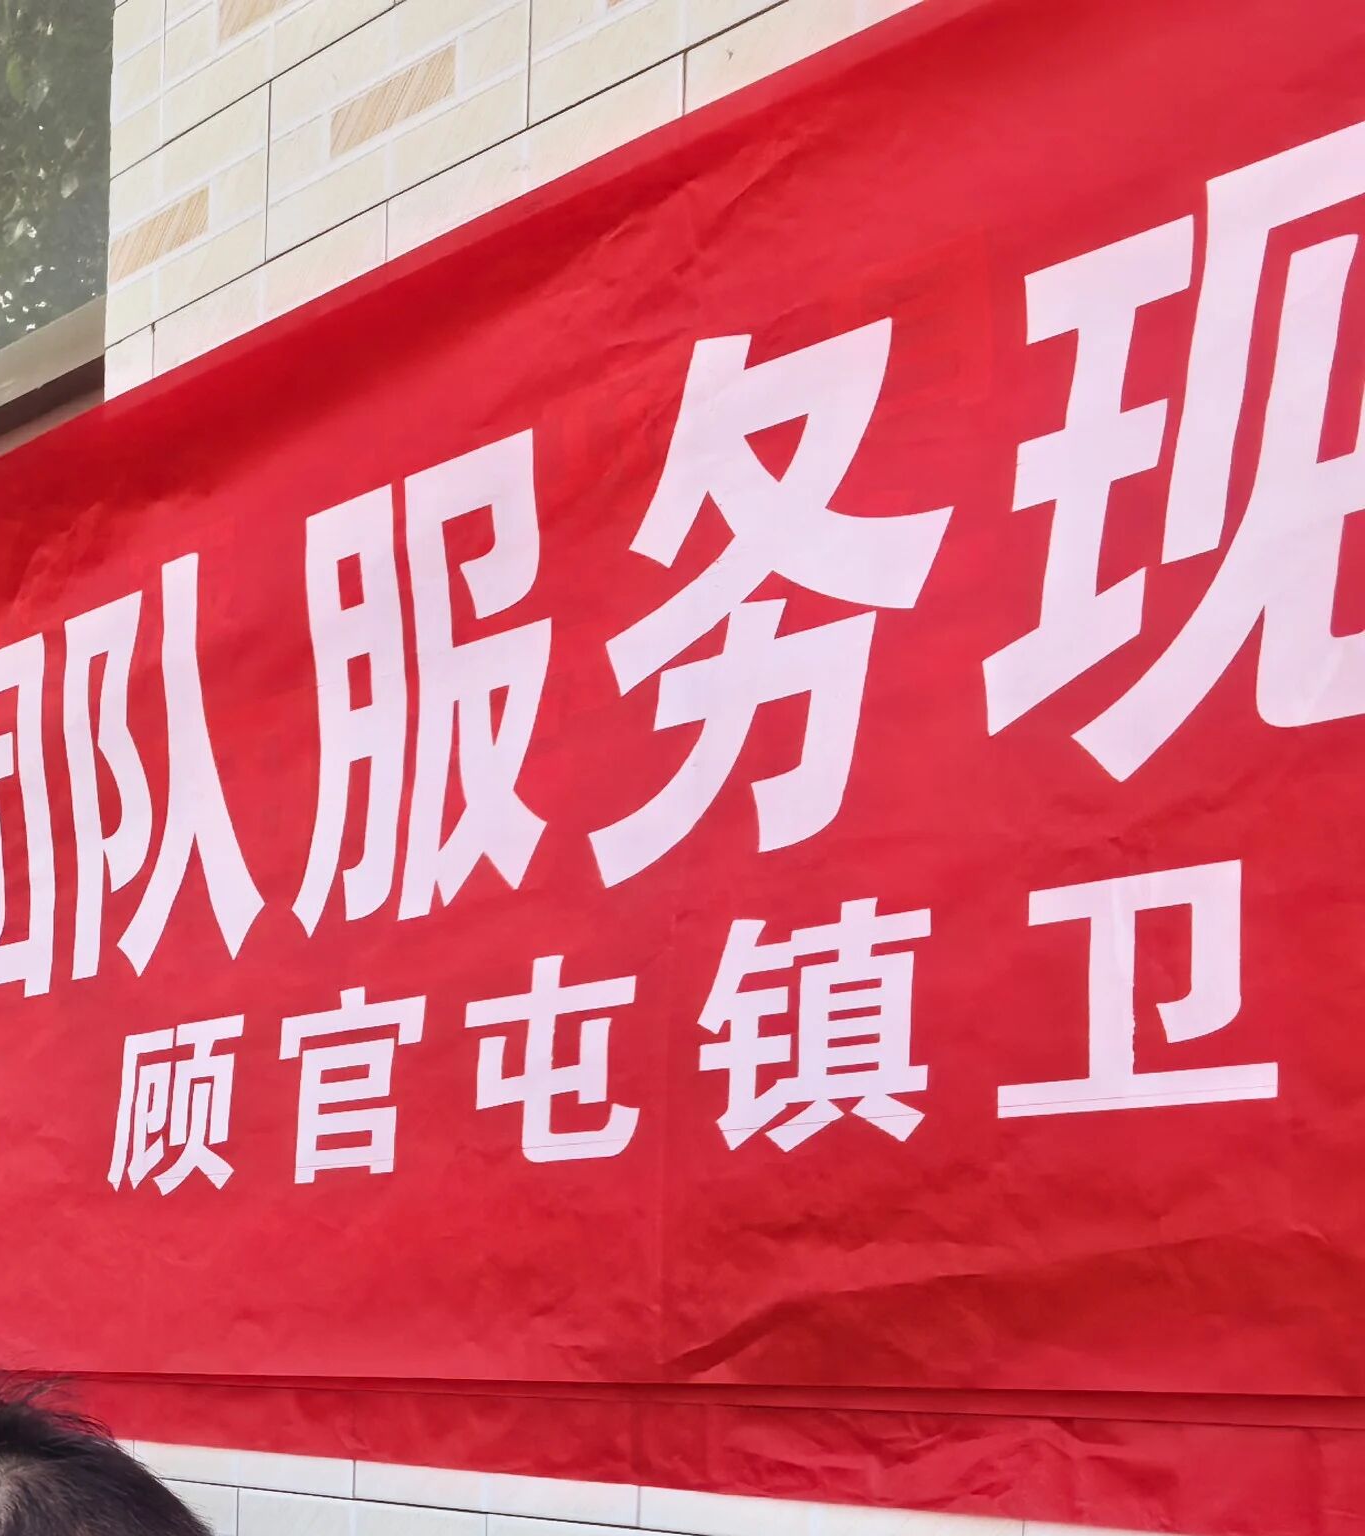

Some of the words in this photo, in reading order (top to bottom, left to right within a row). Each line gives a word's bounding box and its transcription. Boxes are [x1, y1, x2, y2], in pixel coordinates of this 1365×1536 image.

[108, 860, 1277, 1198] 顾官屯镇卫
